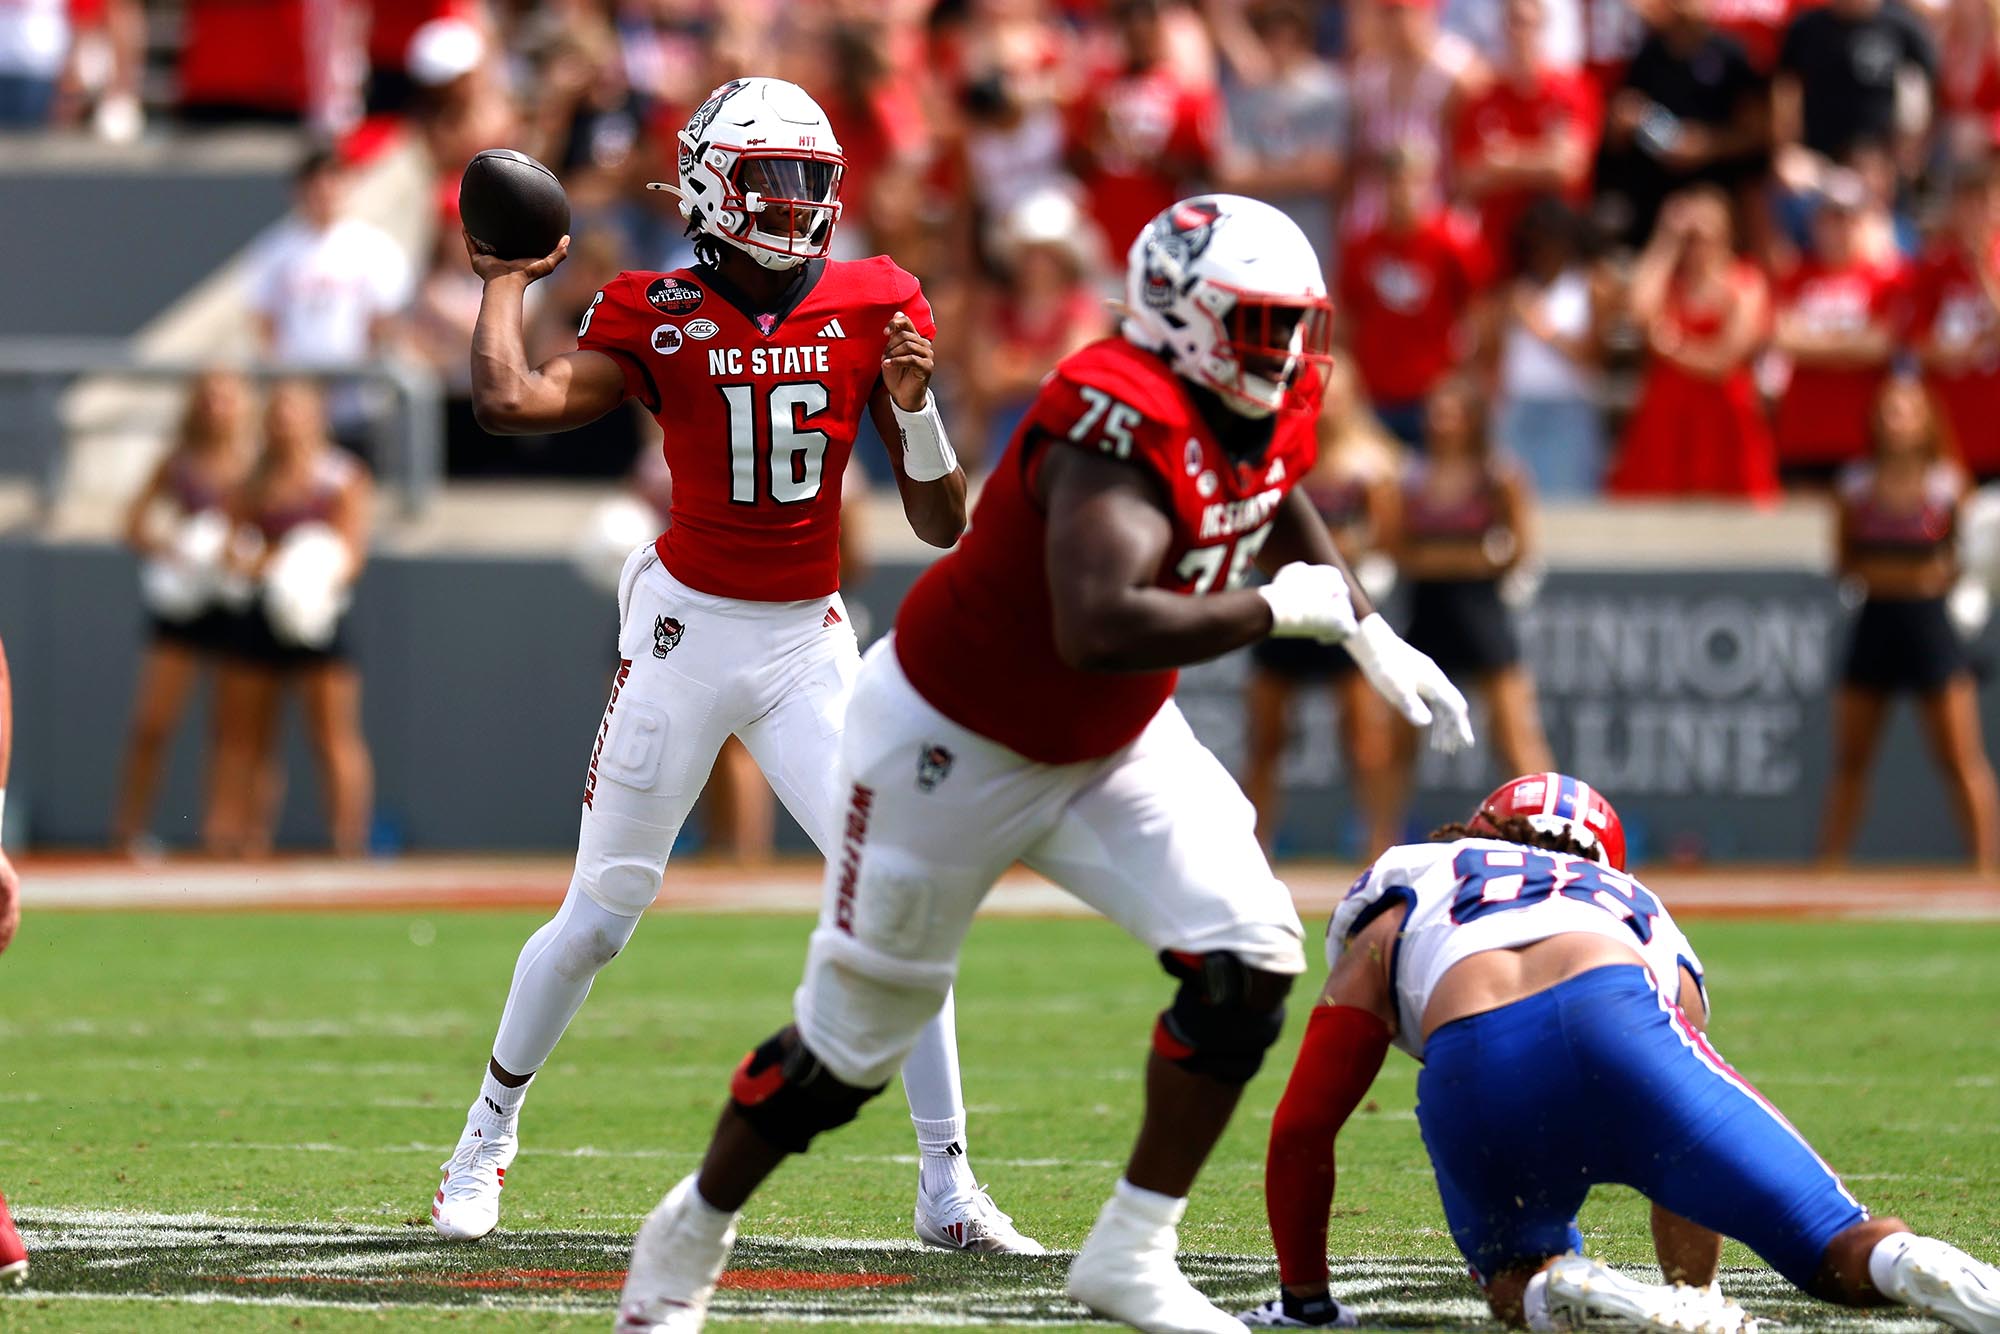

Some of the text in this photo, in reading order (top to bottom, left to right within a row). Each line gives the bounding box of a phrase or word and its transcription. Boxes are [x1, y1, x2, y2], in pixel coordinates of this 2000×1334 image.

[649, 290, 702, 304] WILSON
[658, 287, 690, 296] RUSSELL
[708, 345, 830, 376] NC STATE
[718, 381, 829, 504] 16
[1068, 385, 1142, 459] 75
[583, 658, 633, 812] WOLFPACK
[835, 782, 877, 938] WOLFPACK
